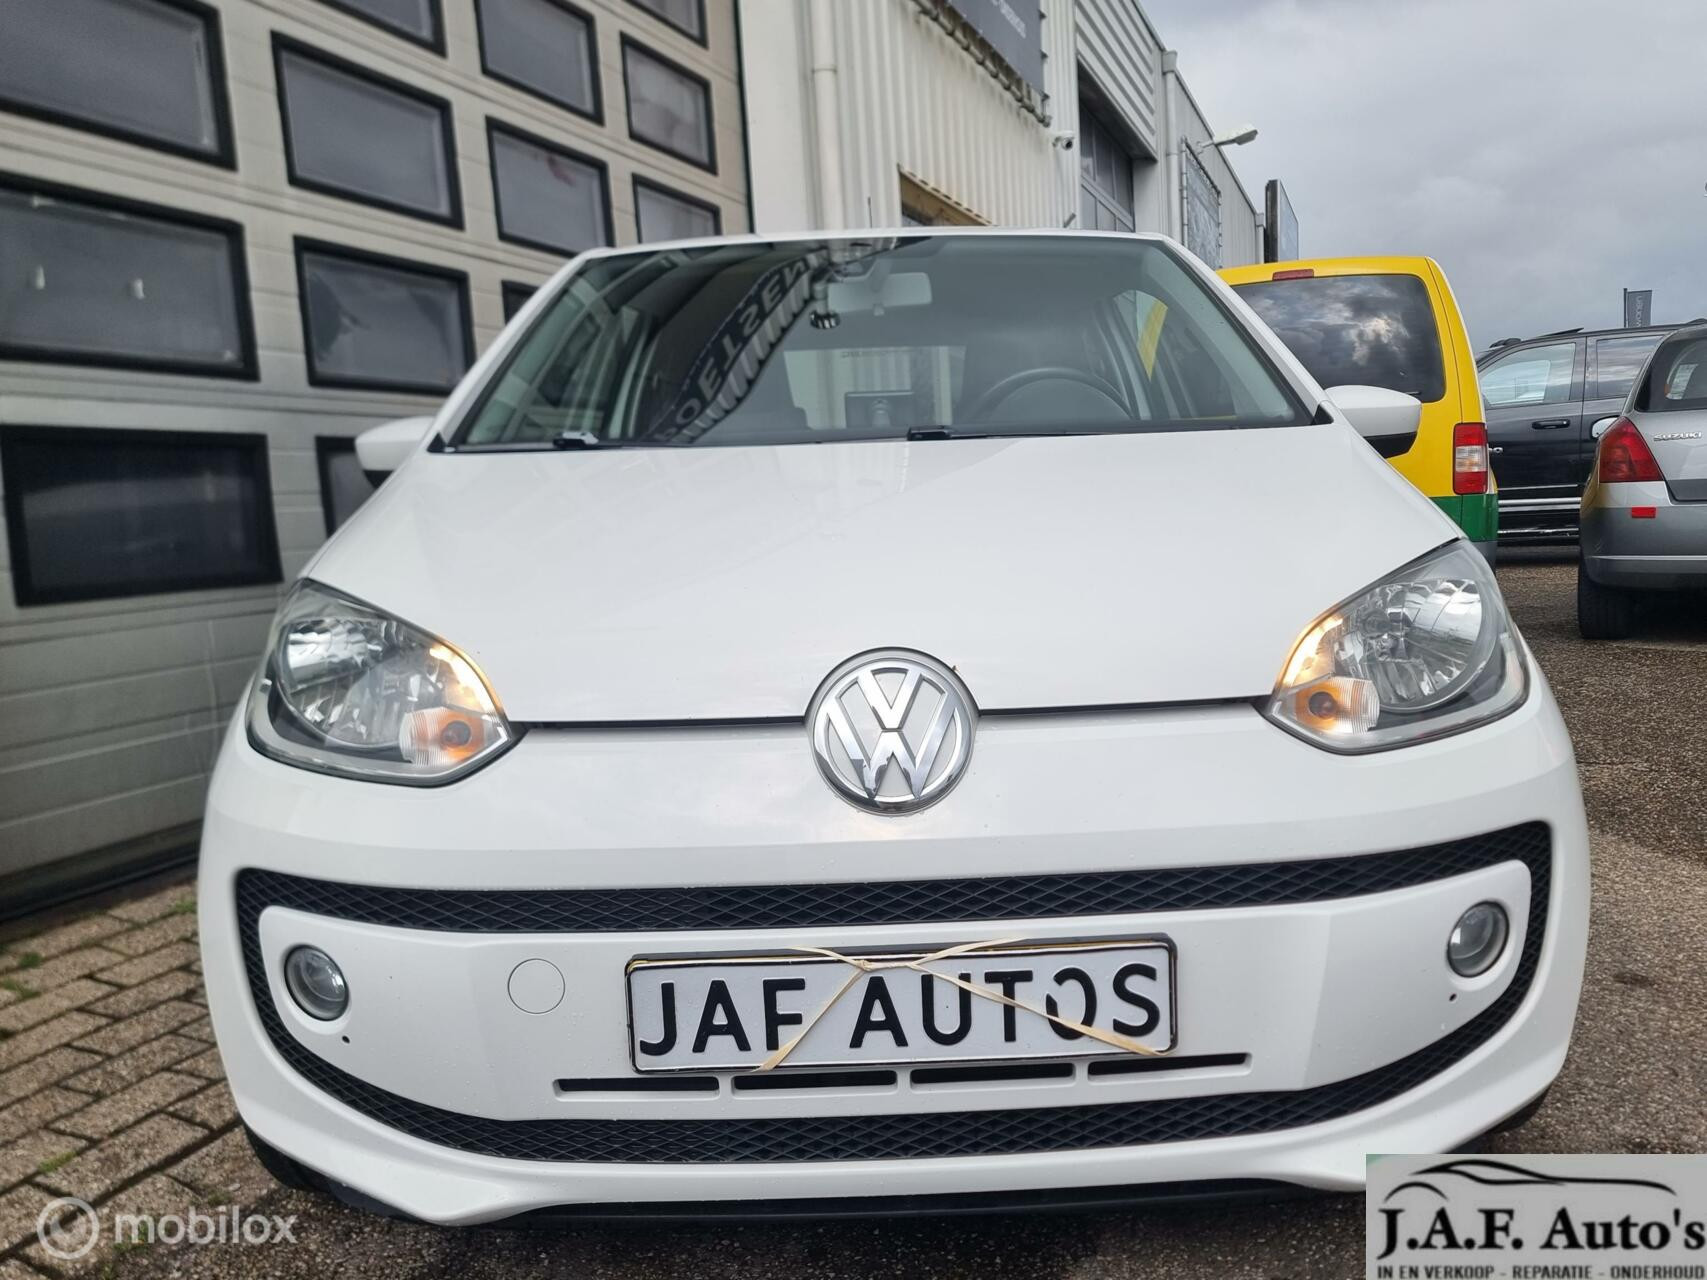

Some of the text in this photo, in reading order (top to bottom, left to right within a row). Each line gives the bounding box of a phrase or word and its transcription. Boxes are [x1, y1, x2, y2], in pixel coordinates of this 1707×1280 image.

[1653, 431, 1702, 442] SUZUKI
[639, 963, 1160, 1056] JAF AUTOS
